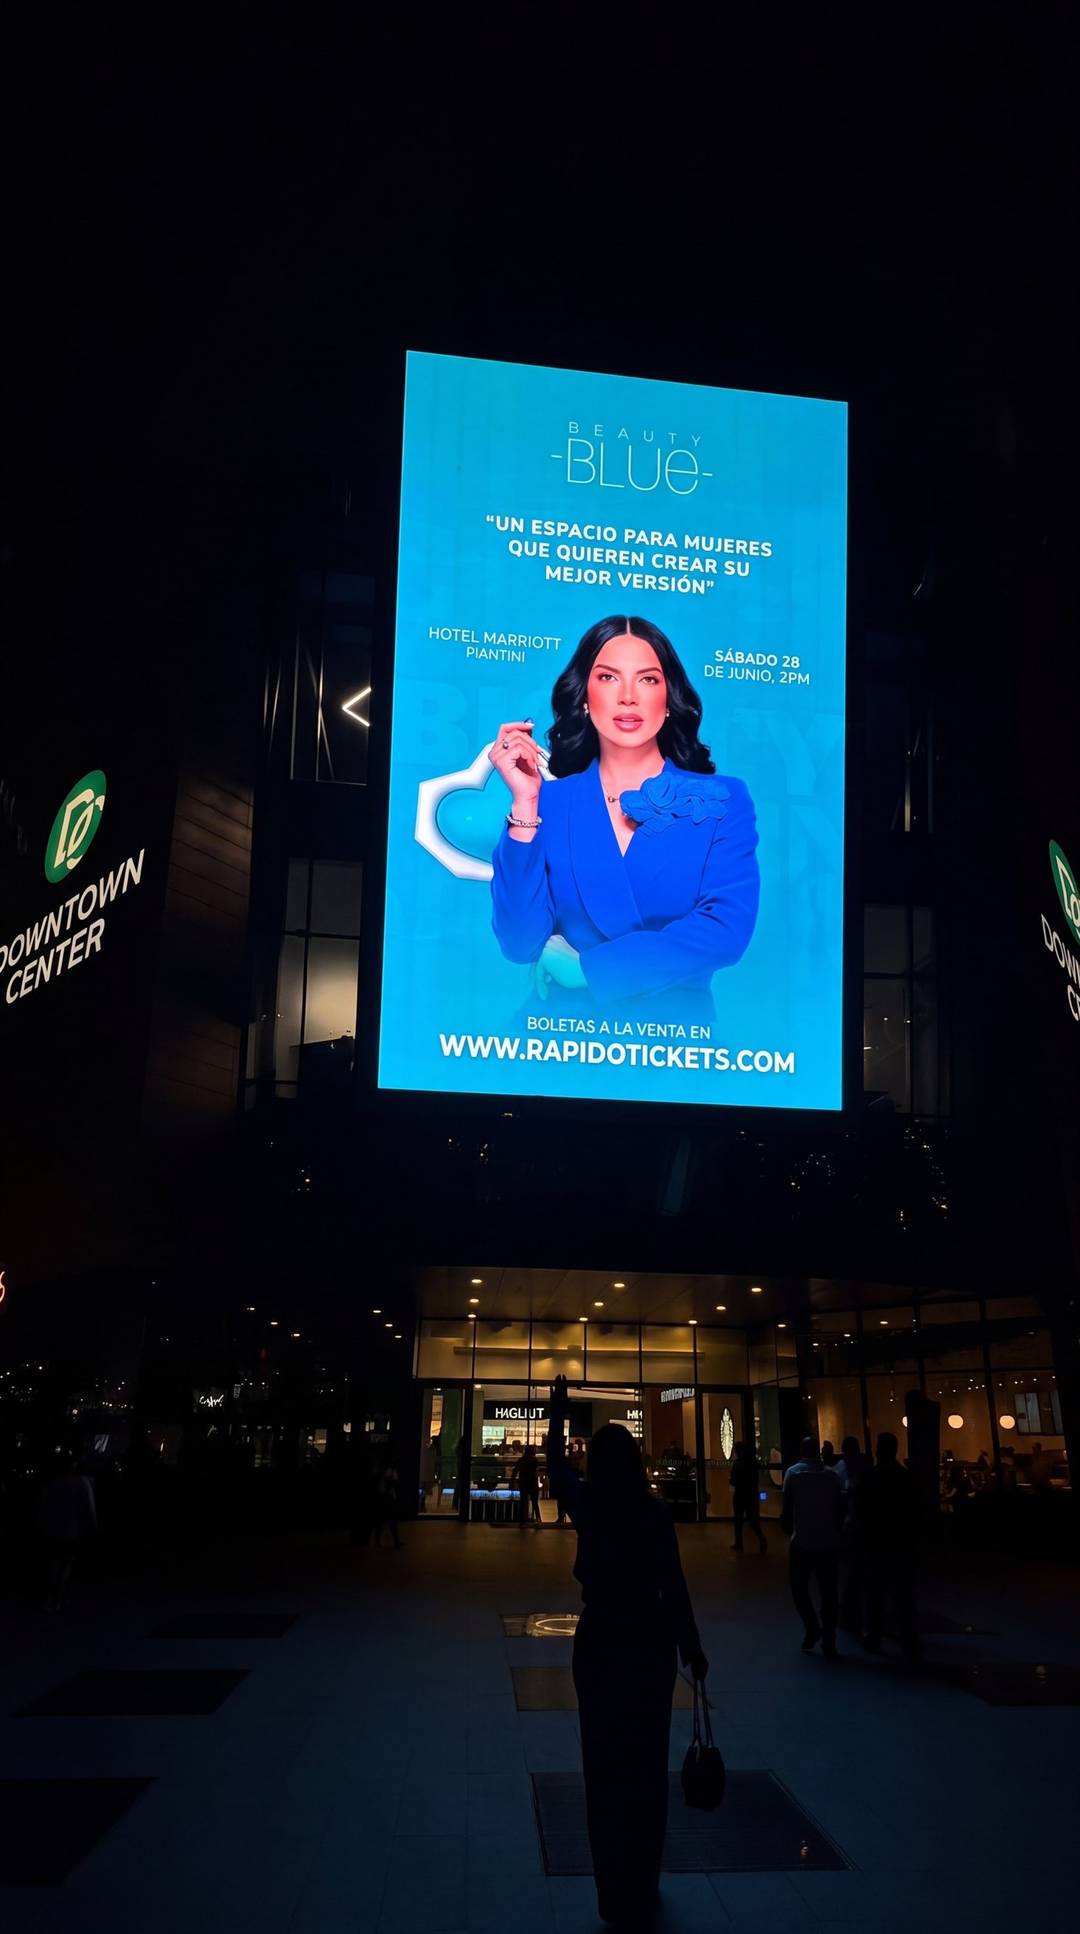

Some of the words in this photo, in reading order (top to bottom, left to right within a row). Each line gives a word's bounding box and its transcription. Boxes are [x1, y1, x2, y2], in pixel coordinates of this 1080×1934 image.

[568, 421, 702, 447] BEAUTY
[531, 519, 617, 542] ESPACIO
[624, 528, 677, 548] PARA
[684, 534, 773, 557] MUJERES
[508, 539, 550, 558] QUE
[556, 543, 645, 567] QUIEREN
[652, 553, 718, 574] CREAR
[724, 561, 750, 577] SU
[545, 564, 612, 586] MEJOR
[428, 626, 479, 643] HOTEL
[483, 631, 562, 650] MARRIOTT
[466, 646, 525, 663] PIANTINI
[714, 647, 778, 666] SÁBADO
[782, 655, 800, 668] 28
[704, 664, 724, 678] DE
[727, 666, 775, 684] JUNIO,
[780, 671, 810, 685] 2PM
[6, 918, 105, 1004] CENTER
[527, 1016, 596, 1034] BOLETAS
[599, 1020, 610, 1034] A
[614, 1021, 634, 1036] LA
[636, 1022, 686, 1038] VENTA
[690, 1025, 711, 1039] EN
[439, 1033, 796, 1074] WWW.RAPIDOTICKETS.COM
